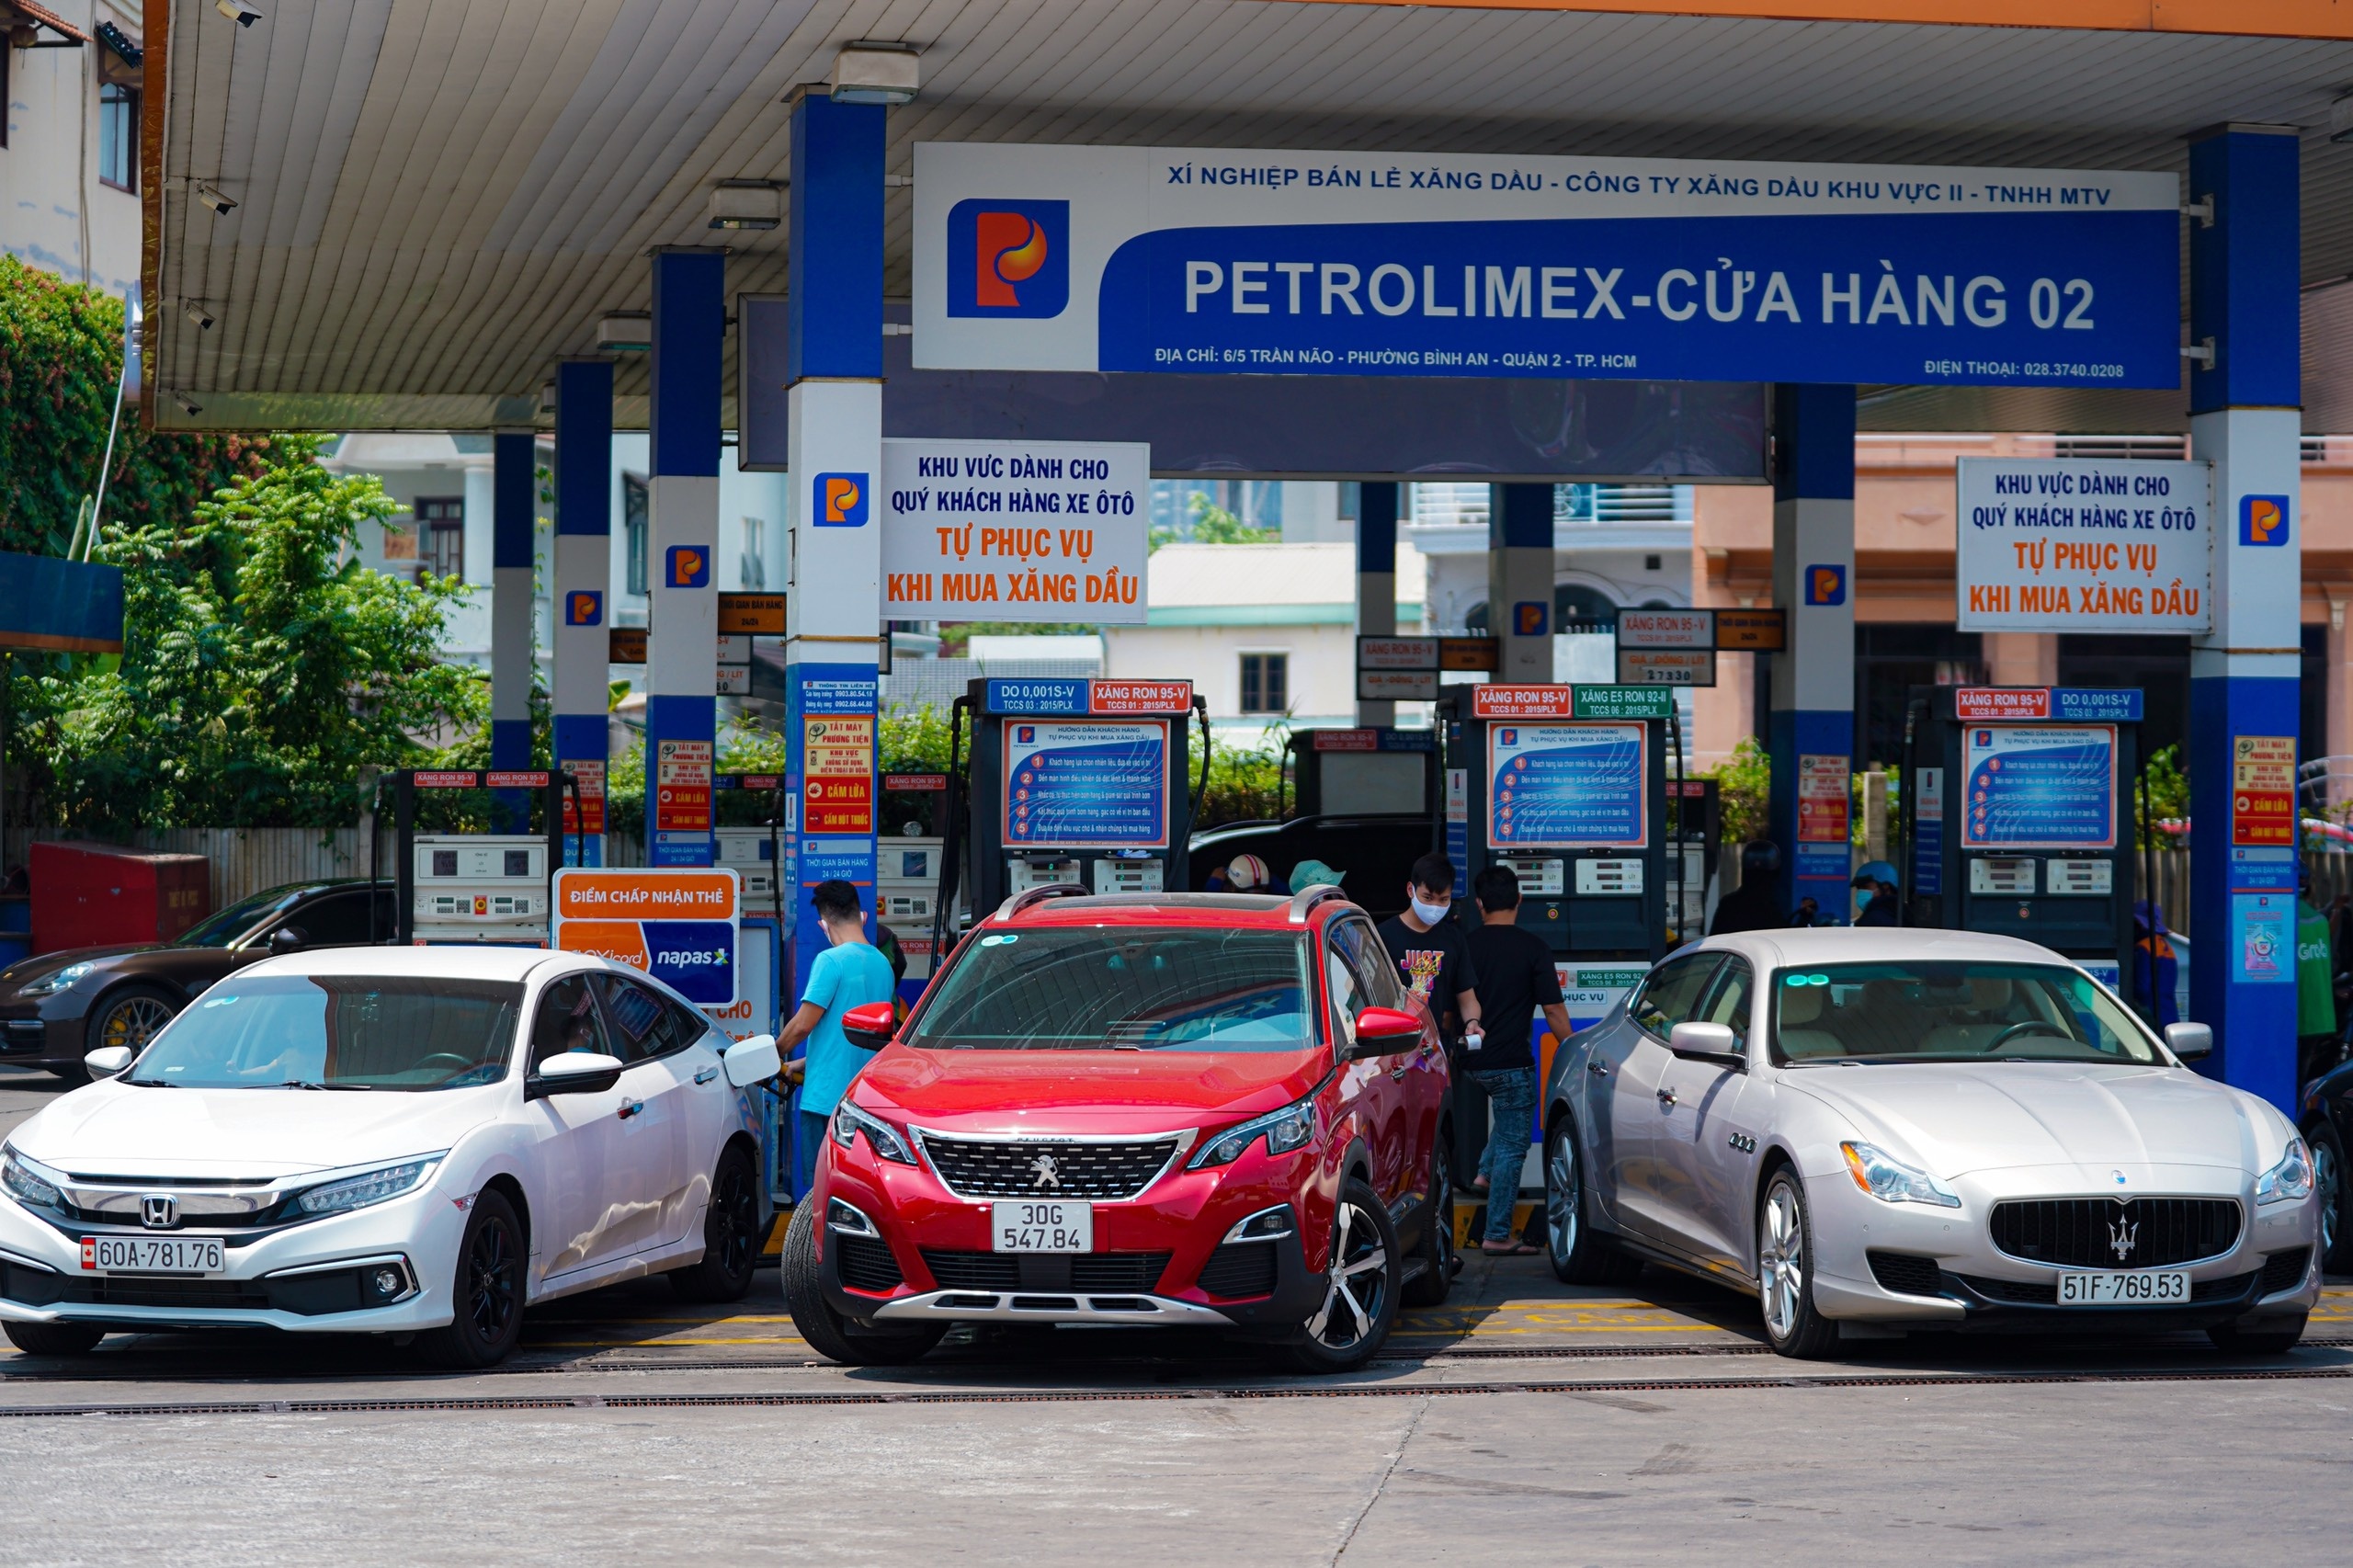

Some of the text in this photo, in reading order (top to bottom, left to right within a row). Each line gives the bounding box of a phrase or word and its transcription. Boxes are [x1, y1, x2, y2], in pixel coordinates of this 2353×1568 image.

[1168, 164, 2110, 206] XÍ NGHIỆP BÁN LẺ XĂNG DẦU CÔNG TY XĂNG DẦU KHU VỰC II TNHH MTV
[1823, 259, 2007, 329] HÀNG
[2029, 278, 2095, 330] 02
[1155, 345, 1636, 370] ĐỊA CHỈ: 6/5 TRẦN NÃO PHƯỜNG BÌNH AN QUẬN 2 TP. HCM
[1925, 358, 2123, 379] ĐIỆN THOẠI: 028.3740.0208
[919, 457, 958, 477] KHU
[1010, 454, 1063, 479] DÀNH
[1070, 459, 1108, 480] CHO
[1996, 471, 2169, 498] KHU VỰC DÀNH CHO
[892, 486, 1134, 516] QUÝ KHÁCH HÀNG XE ÔTÔ
[1972, 503, 2195, 530] QUÝ KHÁCH HÀNG XE ÔTÔ
[937, 522, 1093, 563] TỰ PHỤC VỤ
[2013, 538, 2156, 577] TỰ PHỤC VỤ
[889, 565, 1138, 605] KHI MUA XĂNG DẦU
[1970, 578, 2199, 616] KHI MUA XĂNG DẦU
[1002, 686, 1074, 698] DO 0,001S-V
[1097, 686, 1186, 699] XĂNG RON 95-V
[1481, 688, 1566, 703] XĂNG RON 95-V
[1581, 688, 1608, 702] XĂNG
[1610, 692, 1622, 702] E5
[1625, 692, 1644, 702] RON
[1961, 691, 2044, 705] XĂNG RON 95-V
[2063, 694, 2131, 706] DO 0,001S-V
[1005, 700, 1073, 710] TCCS 03 2015/PLX
[1142, 701, 1175, 710] 2015/PLX
[1490, 705, 1509, 713] TCCS
[1511, 705, 1518, 713] 01
[1590, 706, 1656, 714] TCCS 06 2015/PLX
[827, 783, 865, 798] CẤM LỬA
[571, 887, 723, 906] ĐIỂM CHẤP NHẬN THẺ
[2298, 938, 2327, 960] Grab
[658, 951, 712, 968] napas
[1563, 994, 1603, 1002] HỤC VỤ
[1021, 1205, 1063, 1224] 30G
[1005, 1229, 1080, 1249] 547.84
[99, 1241, 220, 1267] 60A-781.76
[2064, 1274, 2184, 1300] 51F-769.53
